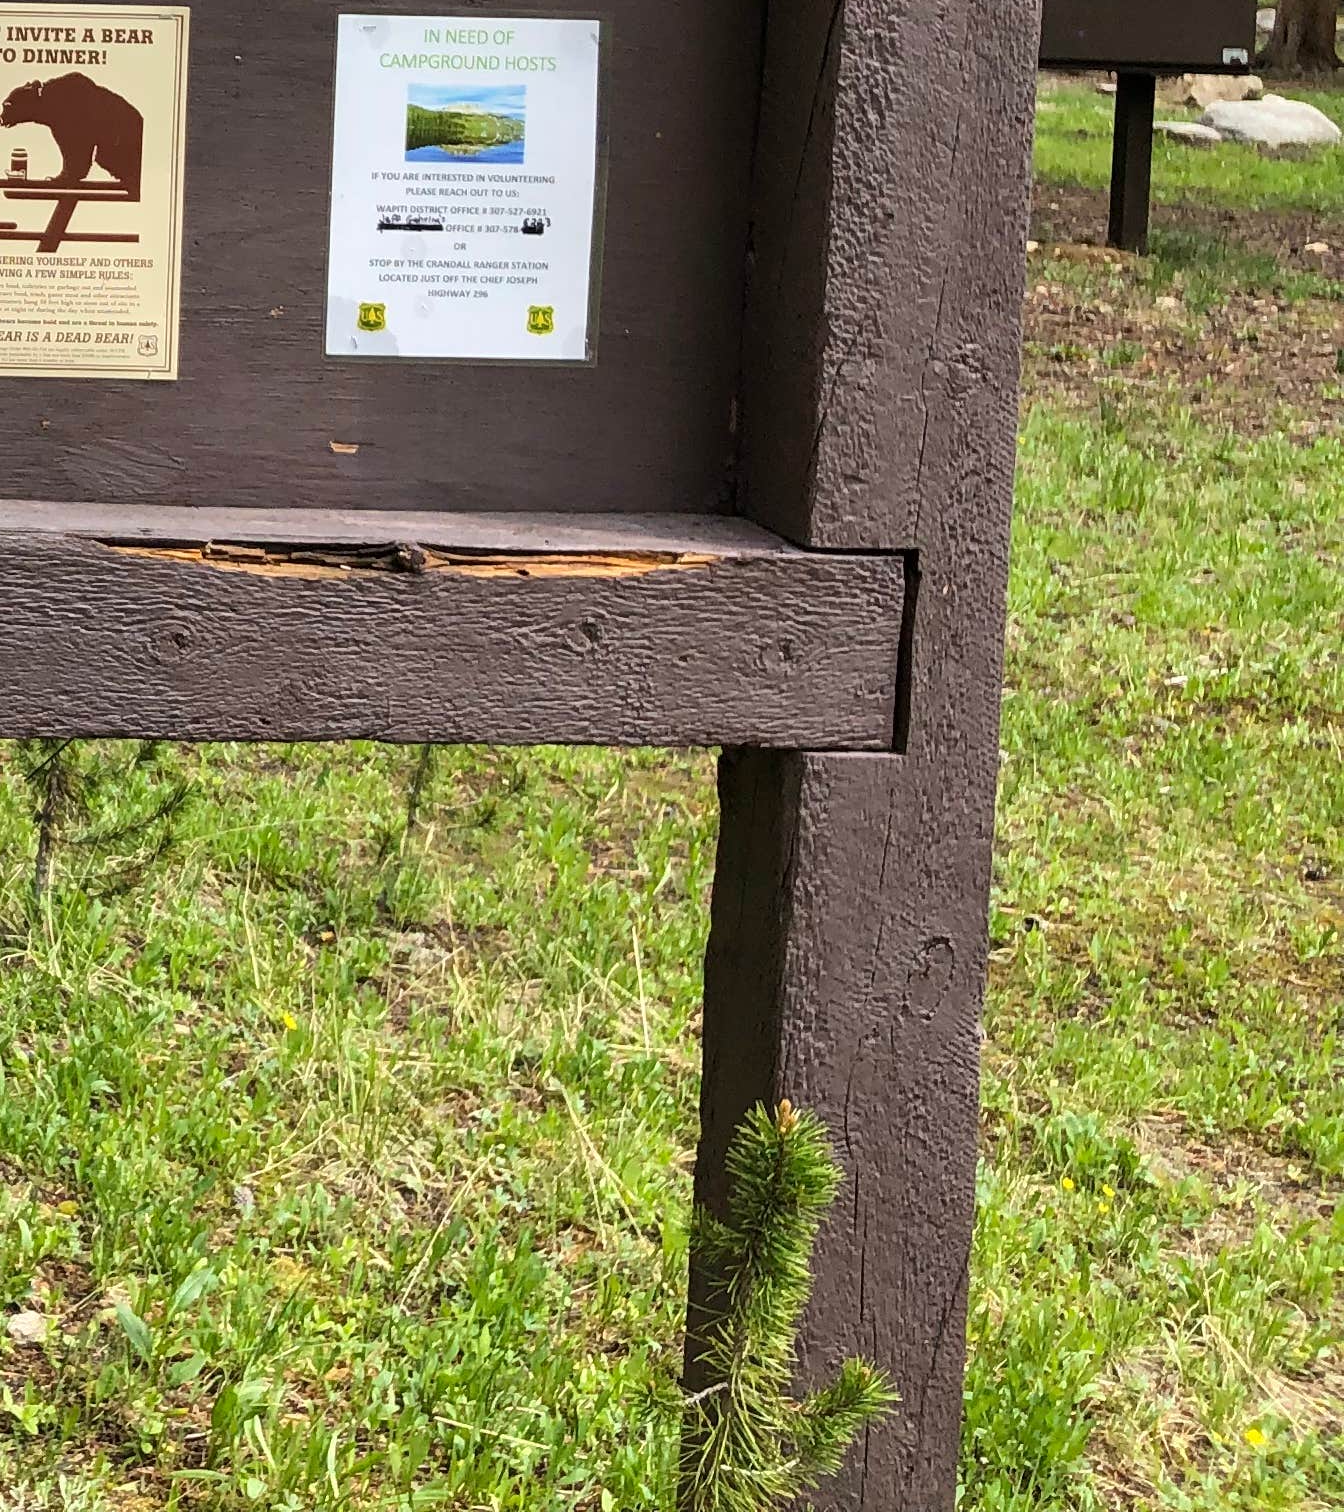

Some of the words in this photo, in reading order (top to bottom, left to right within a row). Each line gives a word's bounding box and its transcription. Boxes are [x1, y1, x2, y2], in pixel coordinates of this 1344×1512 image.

[7, 27, 75, 42] INVITE
[82, 30, 98, 44] A
[102, 30, 153, 44] BEAR
[424, 29, 441, 44] IN
[446, 30, 488, 45] NEED
[493, 31, 514, 45] OF
[22, 48, 107, 65] DINNER!
[380, 54, 500, 70] CAMPGROUND
[505, 55, 557, 71] HOSTS
[428, 290, 470, 298] HIGHWAY
[474, 290, 488, 298] 296
[27, 331, 38, 342] IS
[42, 333, 51, 342] A
[55, 333, 91, 343] DEAD
[96, 333, 133, 344] BEAR!
